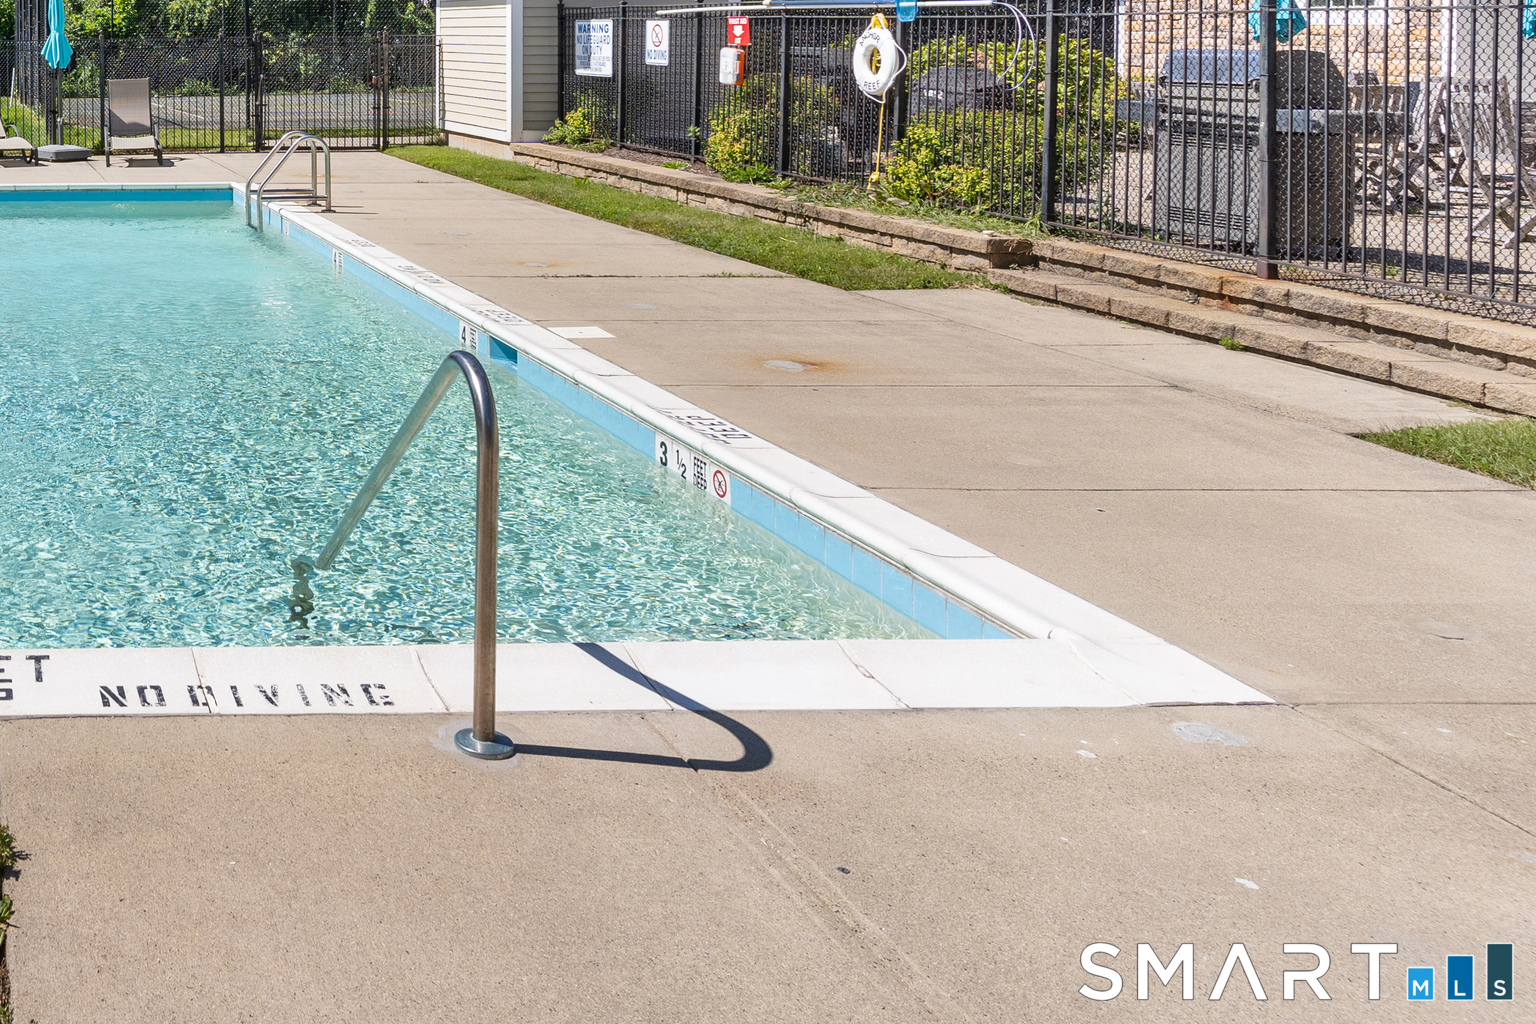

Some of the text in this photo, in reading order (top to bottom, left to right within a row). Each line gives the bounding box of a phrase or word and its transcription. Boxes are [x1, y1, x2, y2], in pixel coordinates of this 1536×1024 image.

[577, 24, 609, 33] WARNING
[576, 35, 610, 44] NO LIFEGUARD
[582, 45, 603, 55] ON DUTY
[647, 50, 667, 61] NO DIVING
[660, 441, 668, 466] 3
[694, 456, 707, 478] FEET
[693, 472, 708, 490] DEEP
[98, 683, 395, 708] NO DIVING
